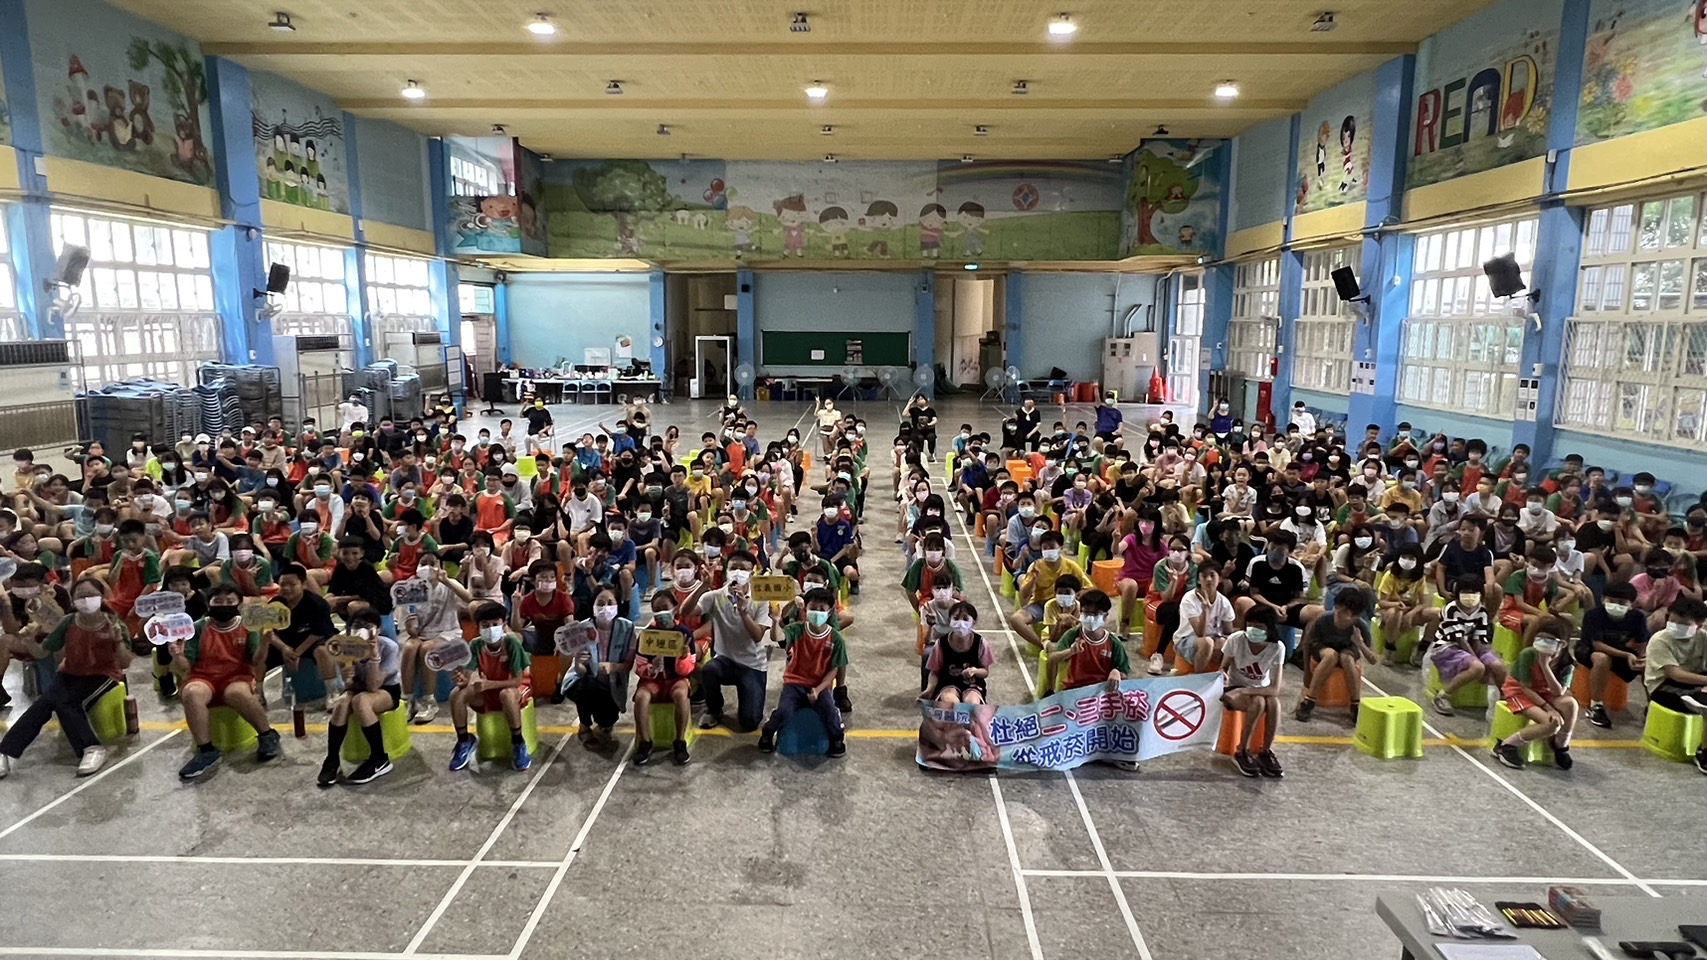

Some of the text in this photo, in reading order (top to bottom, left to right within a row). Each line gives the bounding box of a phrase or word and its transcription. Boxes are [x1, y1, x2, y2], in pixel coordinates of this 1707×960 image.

[1415, 54, 1538, 156] READ
[990, 690, 1149, 745] 杜絕二、三手菸
